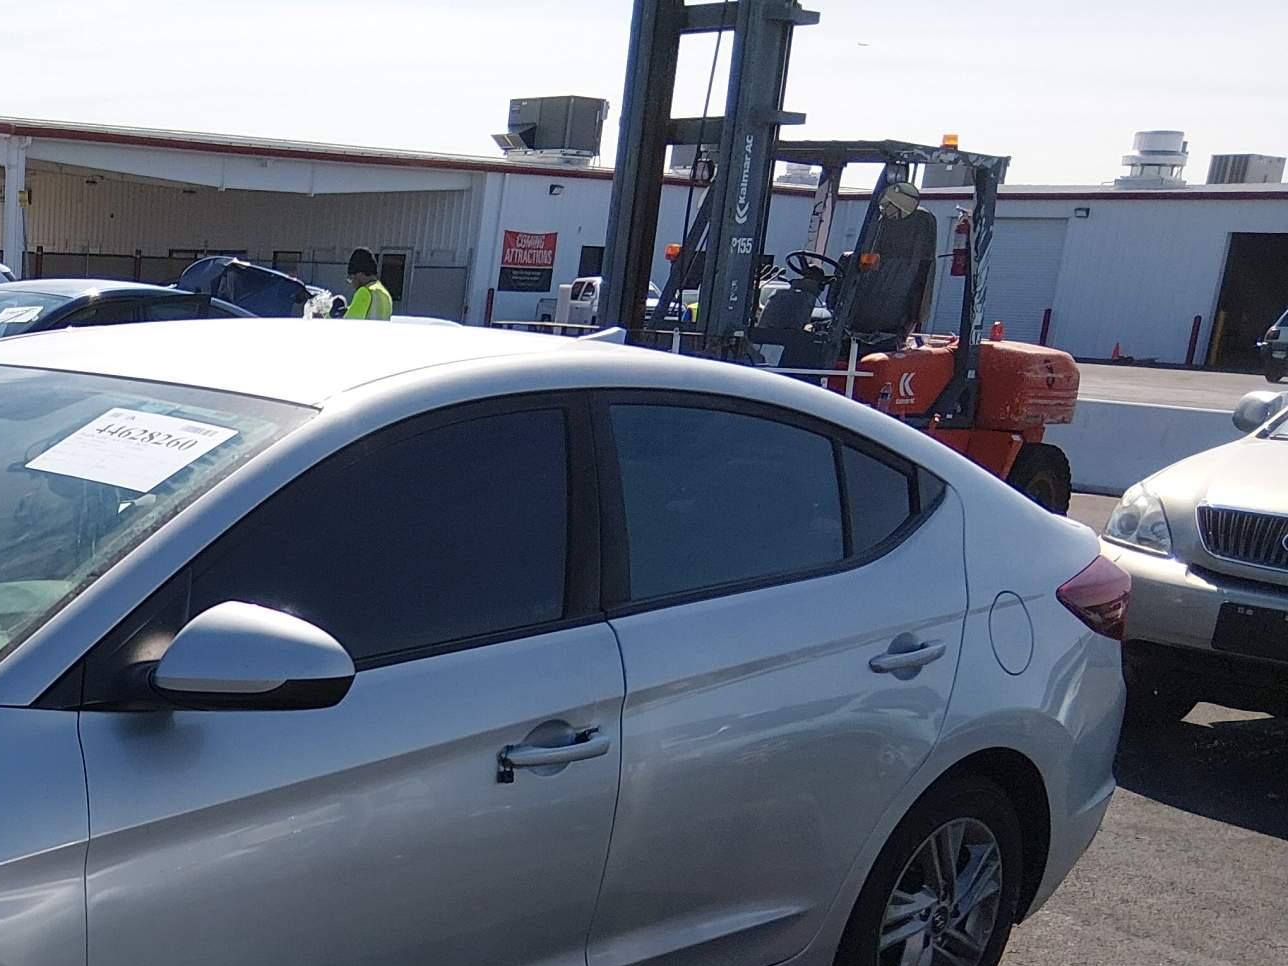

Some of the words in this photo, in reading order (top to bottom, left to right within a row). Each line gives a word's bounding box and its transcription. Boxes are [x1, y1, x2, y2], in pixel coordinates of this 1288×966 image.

[516, 234, 546, 249] COMING
[504, 248, 553, 265] ATTRACTIONS
[96, 422, 199, 452] 44628260
